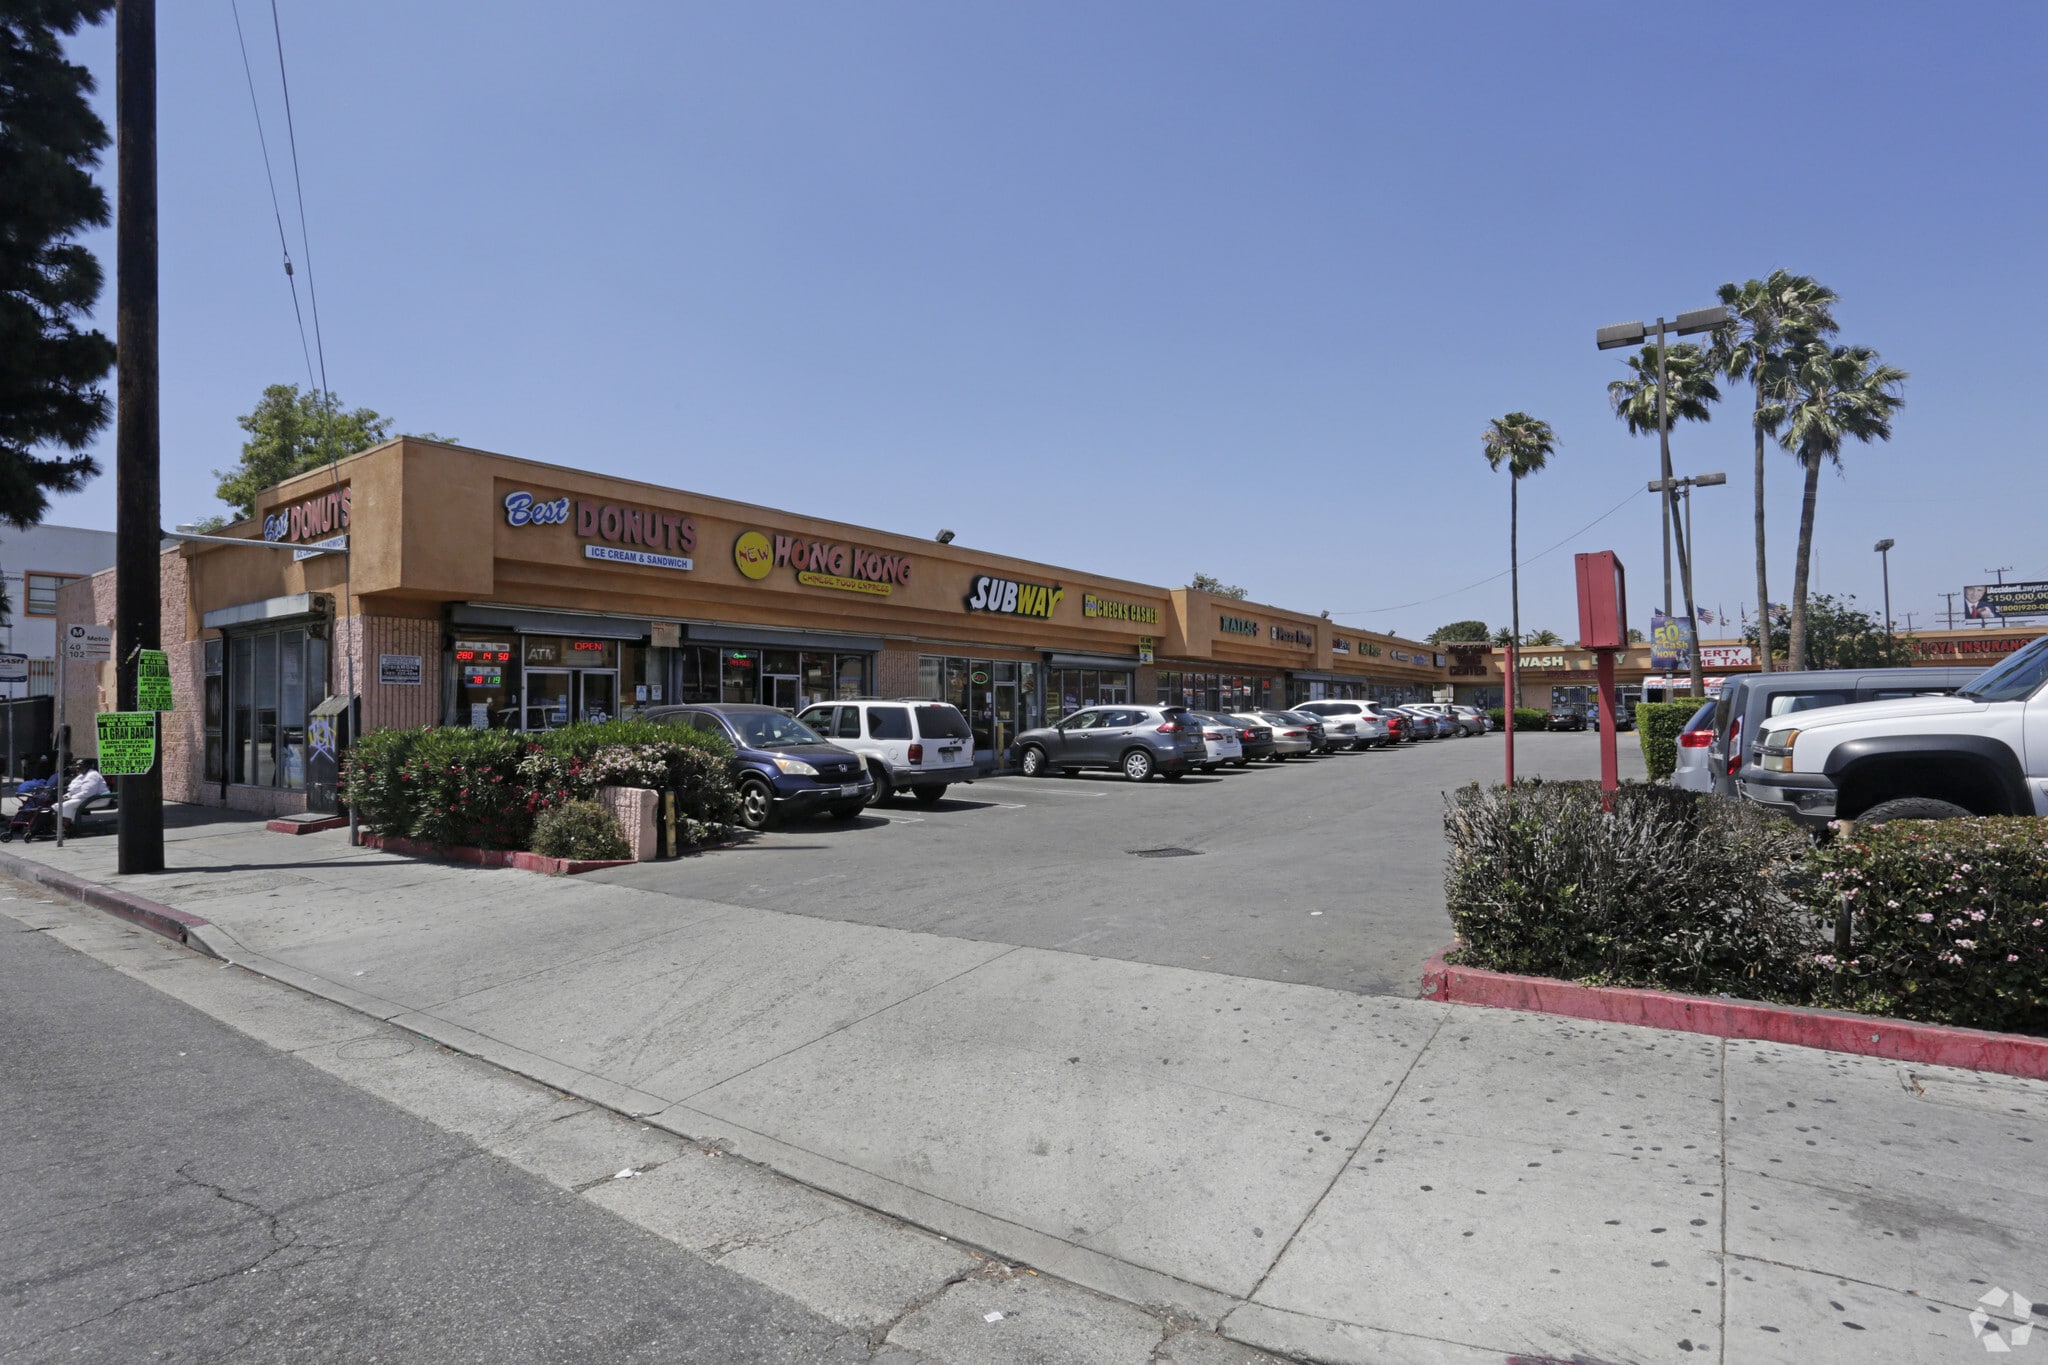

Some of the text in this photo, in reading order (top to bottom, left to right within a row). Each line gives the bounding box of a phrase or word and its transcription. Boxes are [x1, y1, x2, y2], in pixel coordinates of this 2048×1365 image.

[264, 487, 351, 541] Best DONUTS
[506, 491, 698, 552] Best DONUTS
[591, 547, 688, 568] ICE CREAM & SANDWICH
[739, 534, 912, 585] NEW HONG KONG
[803, 574, 889, 593] CHINESE FOOD EXPRESS
[970, 577, 1064, 617] SUBWAY
[1098, 600, 1129, 620] CHECKS
[1130, 606, 1159, 624] CASHED
[457, 651, 473, 659] 280
[574, 642, 602, 651] OPEN
[474, 676, 500, 684] 78 119
[99, 727, 154, 740] LA GRAN BANDA
